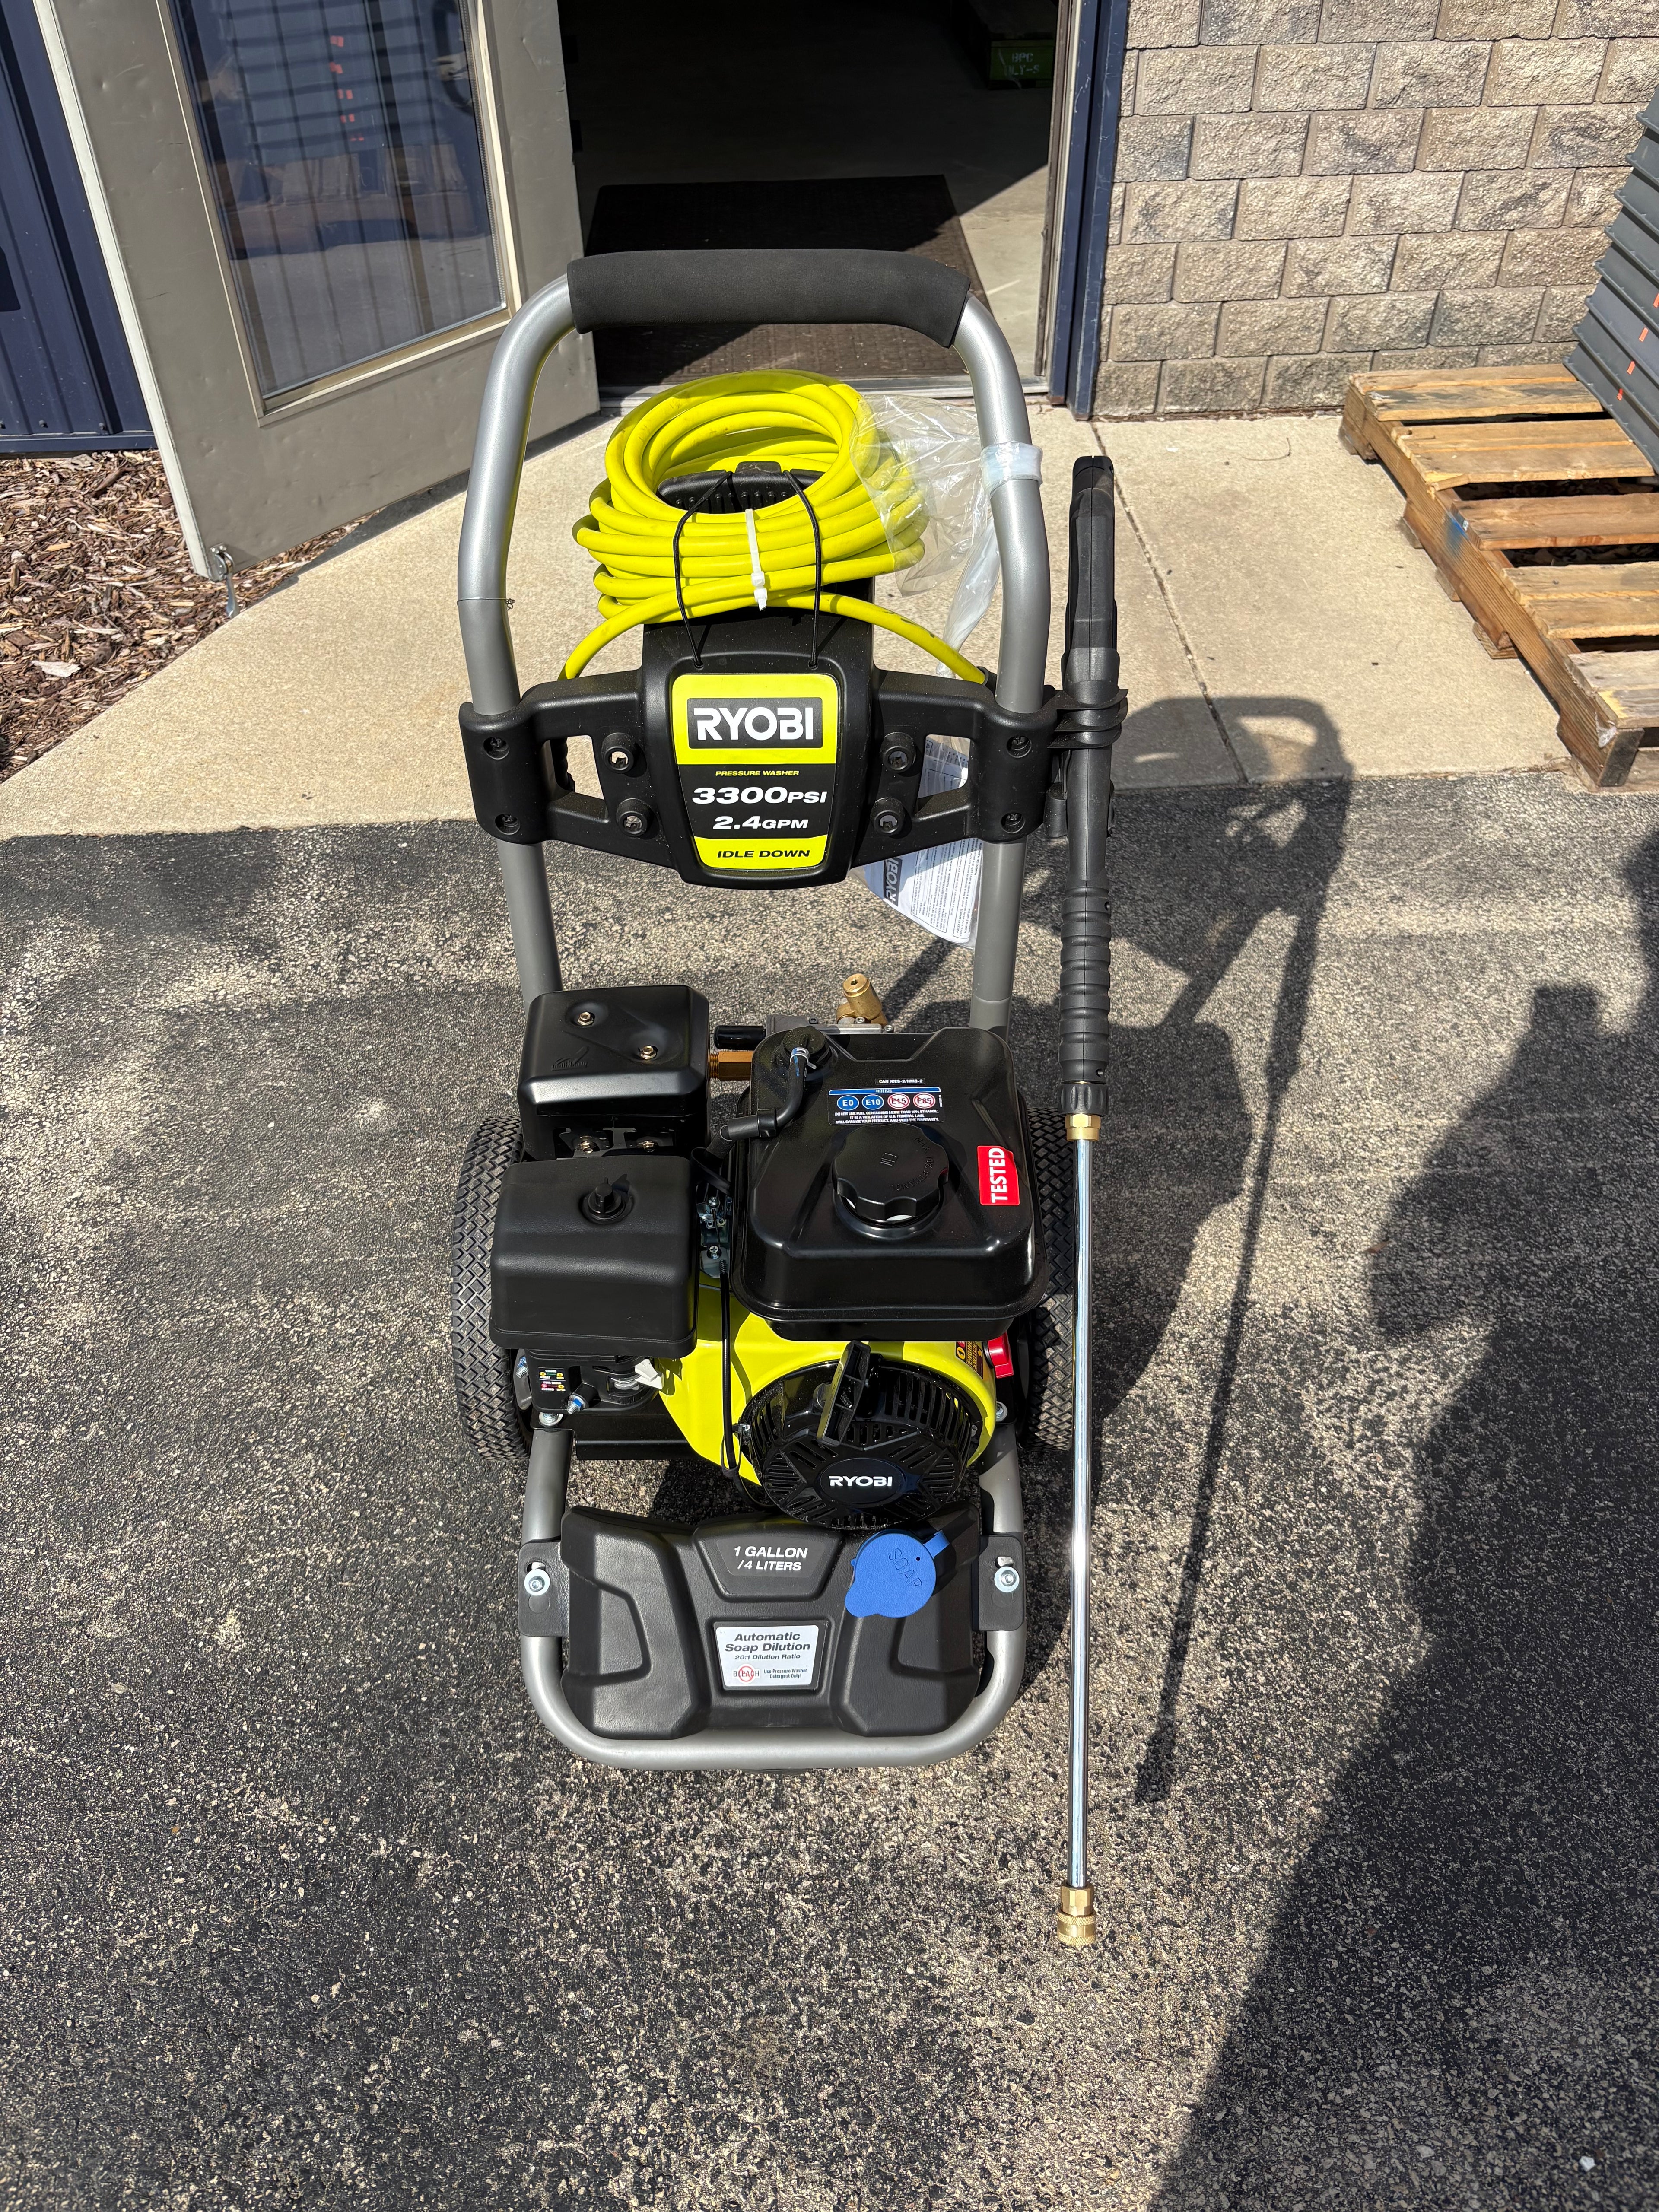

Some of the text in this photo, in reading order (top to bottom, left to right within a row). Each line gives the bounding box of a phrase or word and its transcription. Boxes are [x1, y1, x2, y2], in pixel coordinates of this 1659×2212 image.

[694, 707, 813, 740] RYOBI
[692, 787, 827, 804] 3300PSI
[713, 816, 808, 829] 2.4GPM
[886, 858, 899, 902] RYOBI
[988, 1147, 1008, 1203] TESTED
[829, 1476, 893, 1487] RYOBI
[734, 1546, 808, 1558] 1 GALLON
[756, 1560, 802, 1571] LITERS
[888, 1548, 922, 1586] SOAP
[734, 1632, 801, 1641] Automatic
[725, 1643, 810, 1653] Soap Dilution
